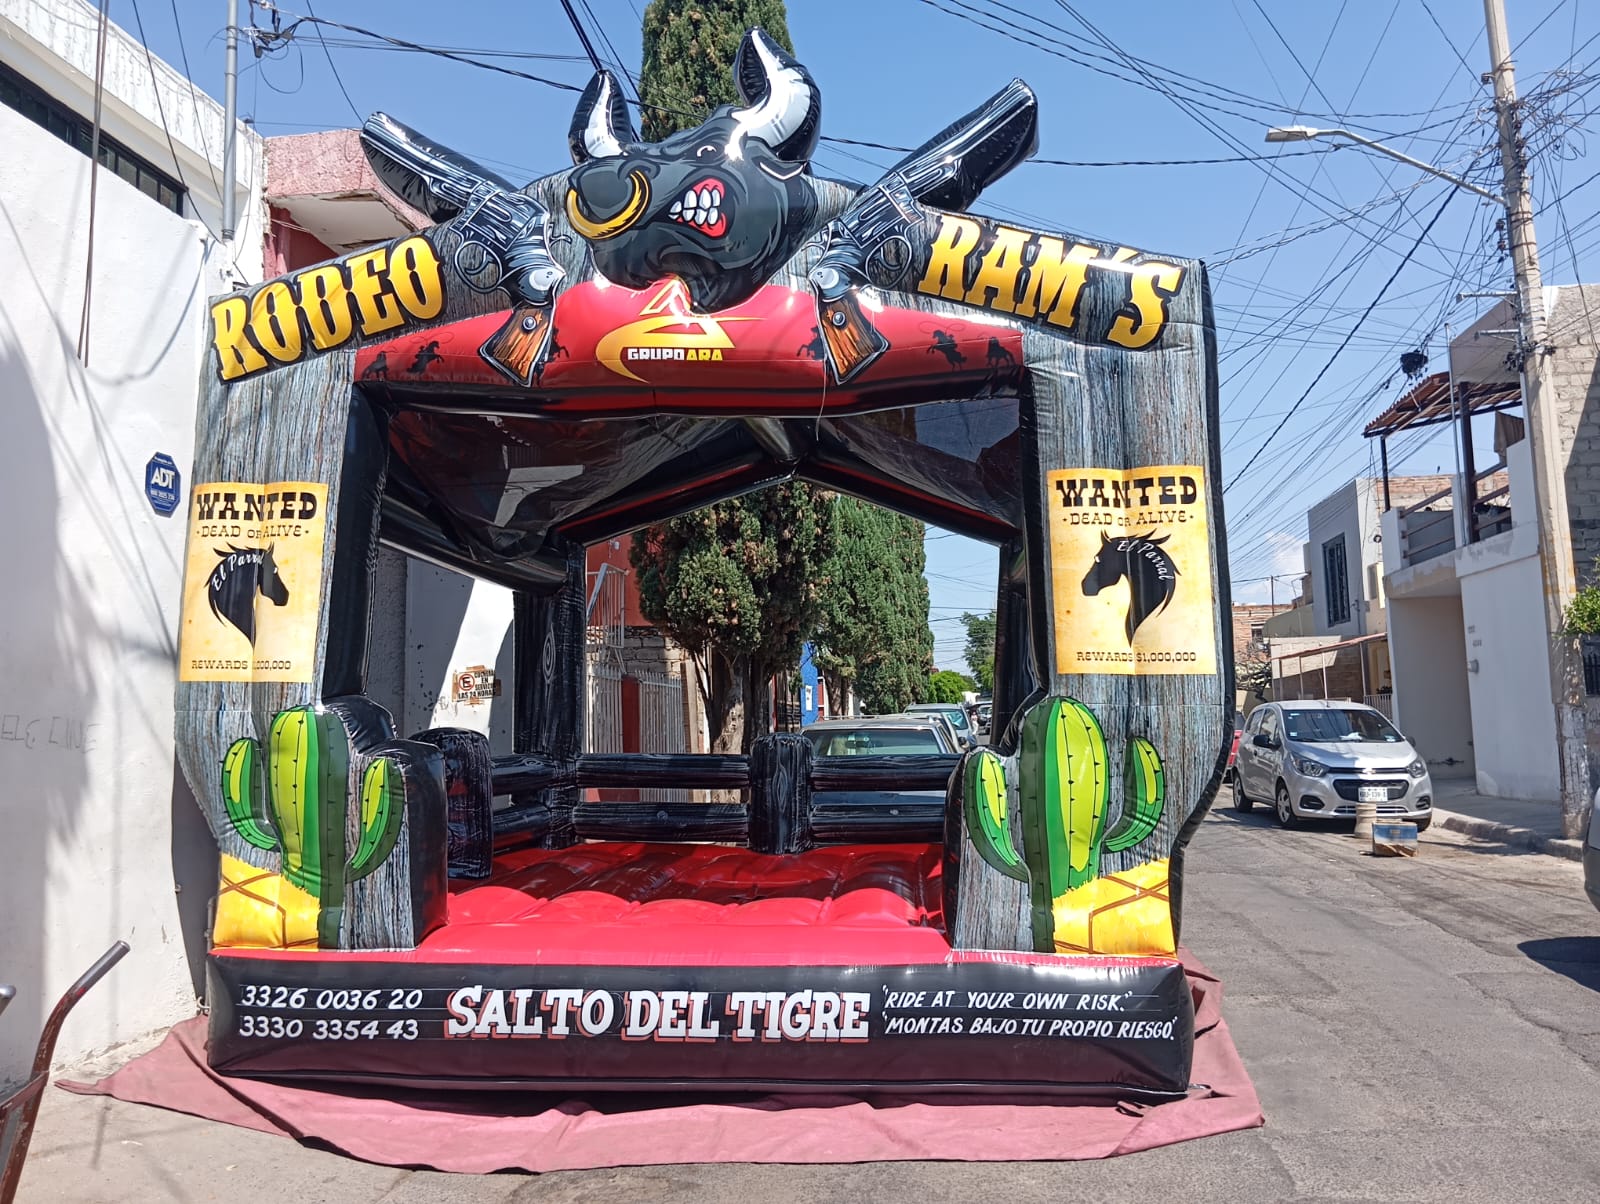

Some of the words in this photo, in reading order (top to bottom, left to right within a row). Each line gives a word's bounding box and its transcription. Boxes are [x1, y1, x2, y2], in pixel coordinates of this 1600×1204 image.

[917, 213, 1185, 349] RAM'S
[210, 235, 445, 382] RODEO
[627, 348, 685, 361] GRUPO
[686, 348, 724, 361] ARA
[151, 466, 175, 489] ADT
[1056, 476, 1197, 508] WANTED
[196, 492, 318, 522] WANTED
[1070, 512, 1113, 526] DEAD
[1117, 516, 1132, 527] OR
[1136, 510, 1187, 526] ALIVE
[200, 525, 241, 538] DEAD
[263, 525, 302, 538] ALIVE
[1116, 539, 1140, 552] El
[1136, 542, 1175, 581] Parral
[211, 564, 227, 592] El
[191, 659, 249, 670] REWARDS
[1076, 651, 1134, 663] REWARDS
[1136, 651, 1197, 663] $1,000,000
[458, 692, 469, 700] LAS
[241, 985, 308, 1009] 3326
[316, 988, 382, 1010] 0036
[388, 988, 423, 1010] 20
[931, 990, 956, 1009] AT
[967, 991, 1014, 1010] YOUR
[1022, 992, 1067, 1011] OWN
[443, 985, 616, 1038] SALTO
[621, 990, 720, 1041] DEL
[725, 989, 871, 1042] TIGRE
[239, 1015, 304, 1039] 3330
[312, 1018, 380, 1040] 3354
[386, 1018, 419, 1040] 43
[969, 1017, 1017, 1035] BAJO
[1021, 1018, 1046, 1036] TU
[1048, 1019, 1113, 1038] PROPIO
